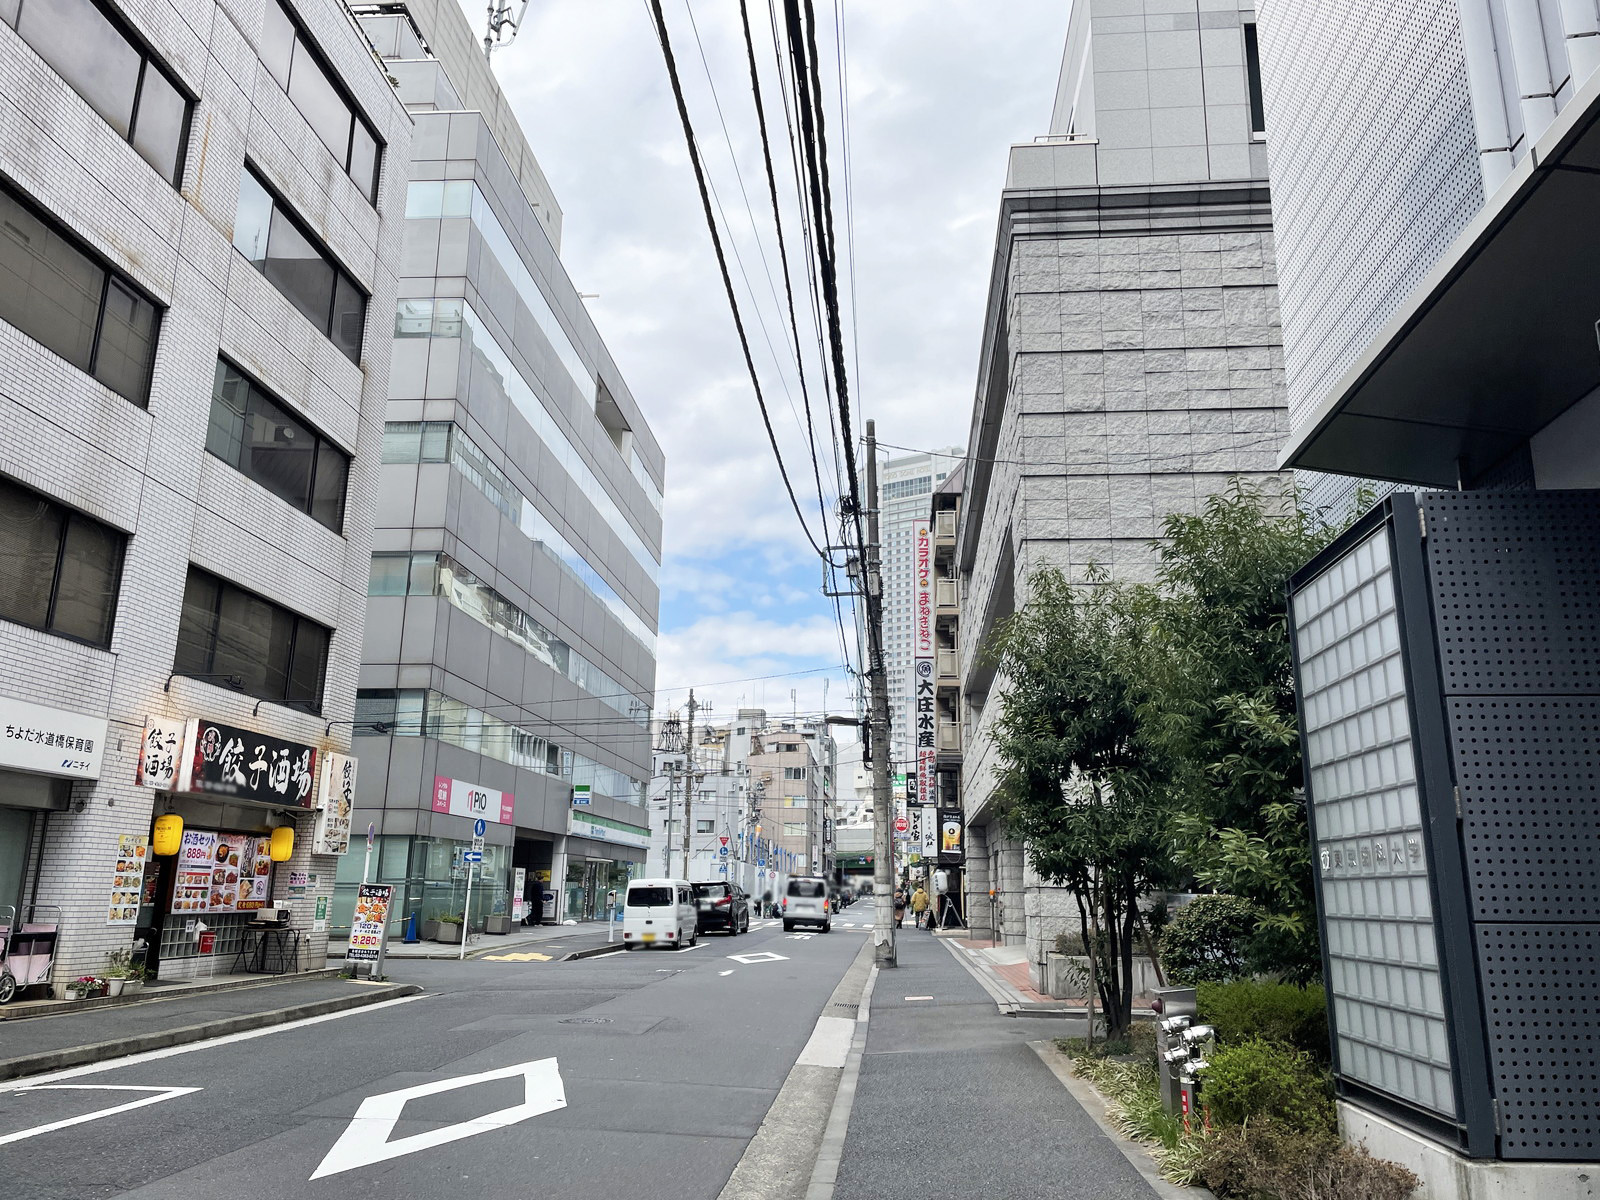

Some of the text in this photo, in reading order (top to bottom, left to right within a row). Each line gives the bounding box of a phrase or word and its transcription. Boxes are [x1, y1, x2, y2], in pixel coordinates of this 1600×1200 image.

[918, 537, 929, 579] カラオケ
[919, 592, 930, 651] まねきねこ
[918, 679, 935, 748] 大庄水産
[6, 725, 94, 753] ちよだ水道橋保育園
[148, 729, 176, 753] 餃子
[73, 761, 90, 771] ニチイ
[145, 754, 173, 780] 酒場
[219, 737, 312, 800] 餃子酒場
[184, 833, 216, 846] お酒セット
[187, 848, 206, 859] 888円
[362, 888, 389, 897] 餃子酒場
